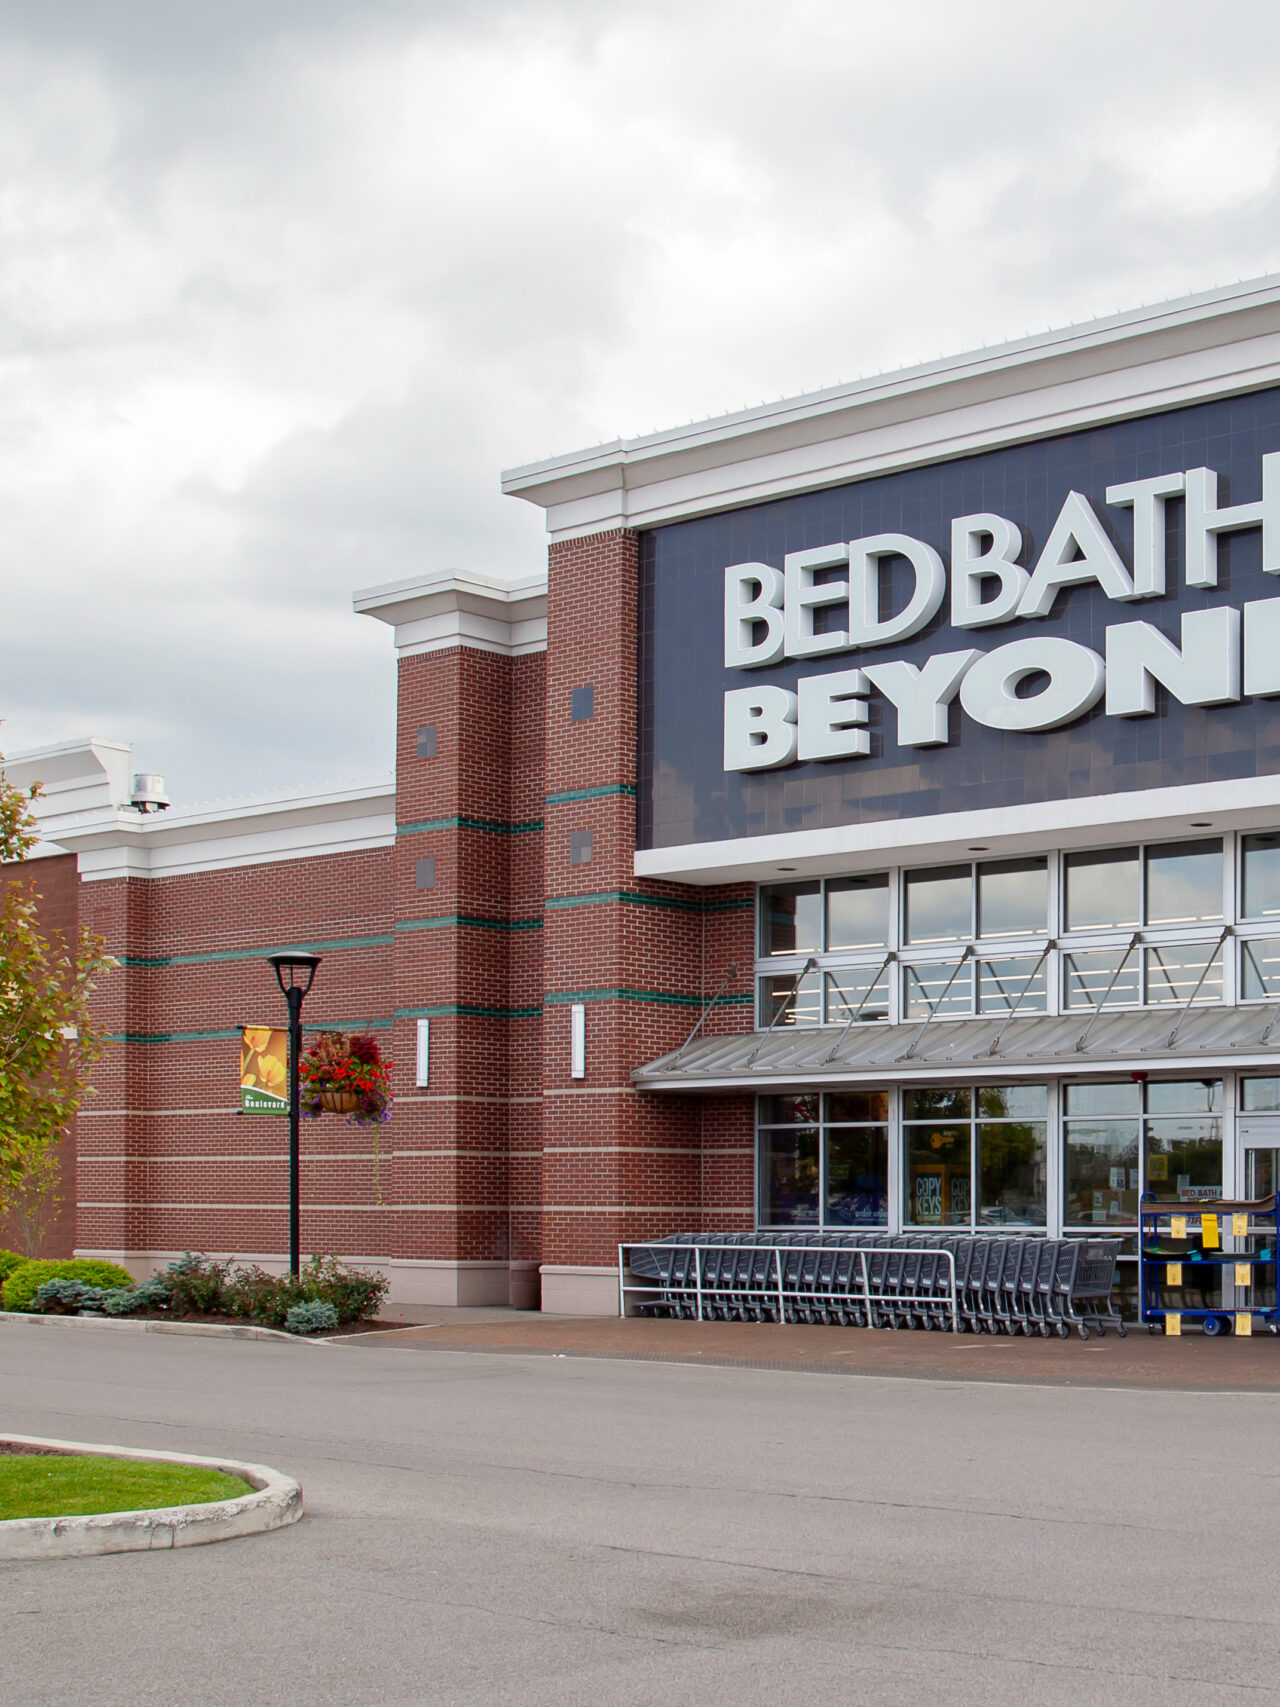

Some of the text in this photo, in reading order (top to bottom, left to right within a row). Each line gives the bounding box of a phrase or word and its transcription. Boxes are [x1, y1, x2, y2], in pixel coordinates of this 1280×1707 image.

[724, 532, 947, 670] BED
[244, 1100, 286, 1109] Boulevard
[916, 1177, 942, 1196] COPY
[951, 1178, 971, 1196] COP
[1181, 1188, 1196, 1197] BED
[1198, 1188, 1217, 1197] BATH
[916, 1196, 942, 1215] KEYS
[951, 1196, 971, 1214] KEY
